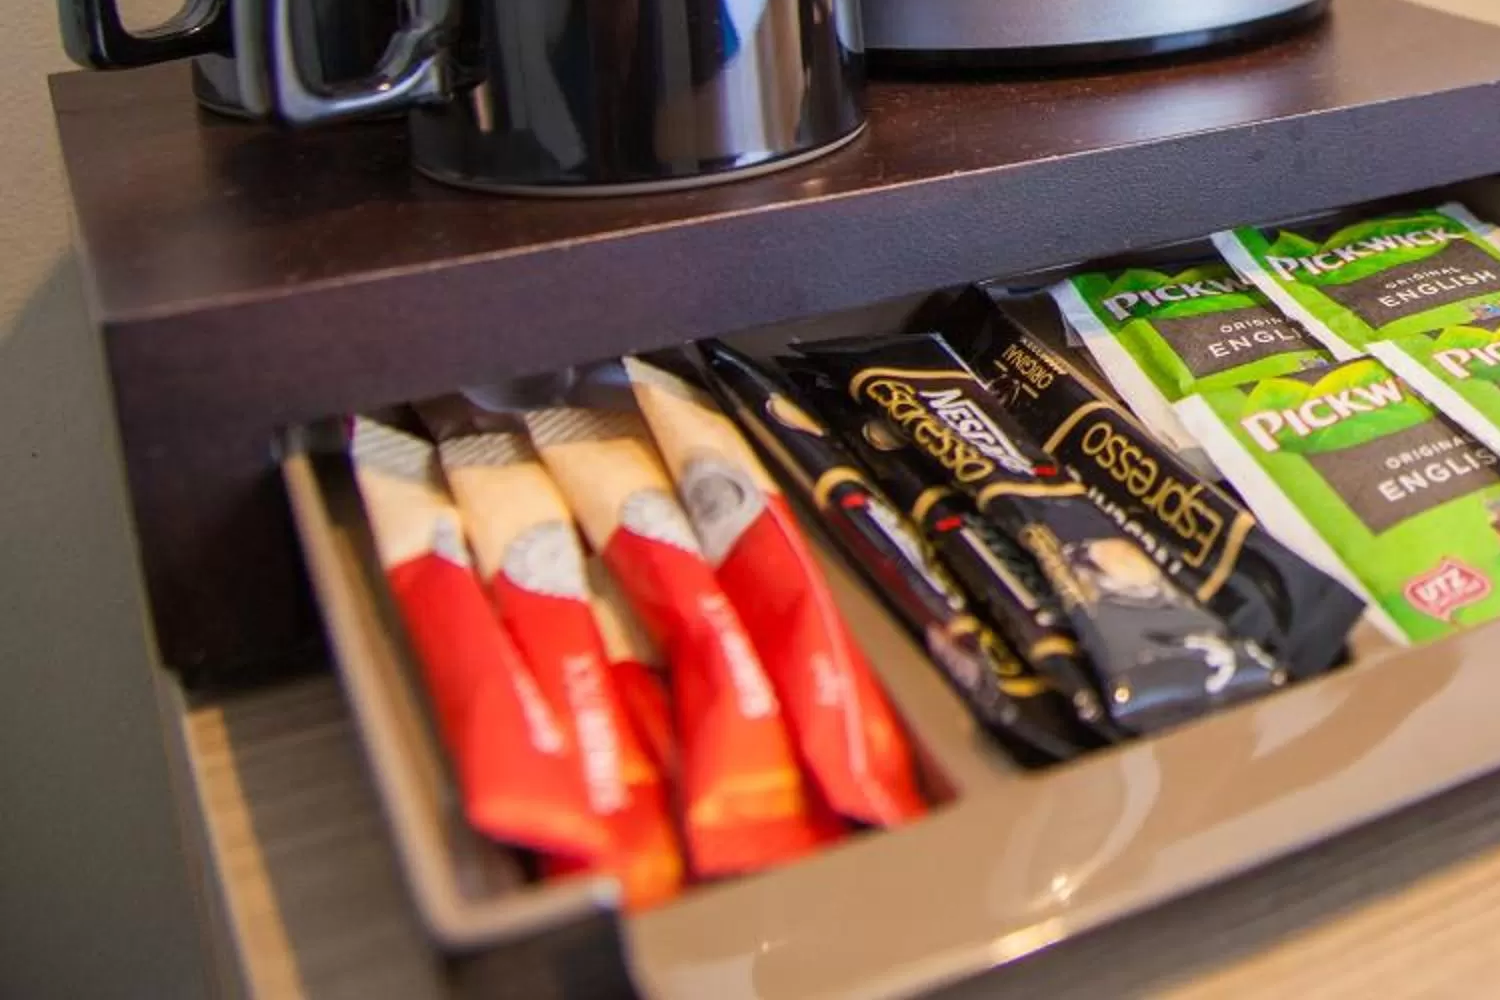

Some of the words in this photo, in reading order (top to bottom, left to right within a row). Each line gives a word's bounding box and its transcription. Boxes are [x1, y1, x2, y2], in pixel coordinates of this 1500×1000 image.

[1265, 227, 1462, 281] PICKWICK
[1102, 276, 1250, 321] PICKW
[1378, 270, 1497, 308] ENGLISH
[1385, 267, 1463, 289] ORIGINAL
[1208, 326, 1302, 359] ENGLI
[1220, 316, 1283, 334] ORIGIN
[1241, 377, 1406, 452] PICKW
[1081, 421, 1223, 568] Espresso
[1377, 447, 1497, 502] ENGLIS
